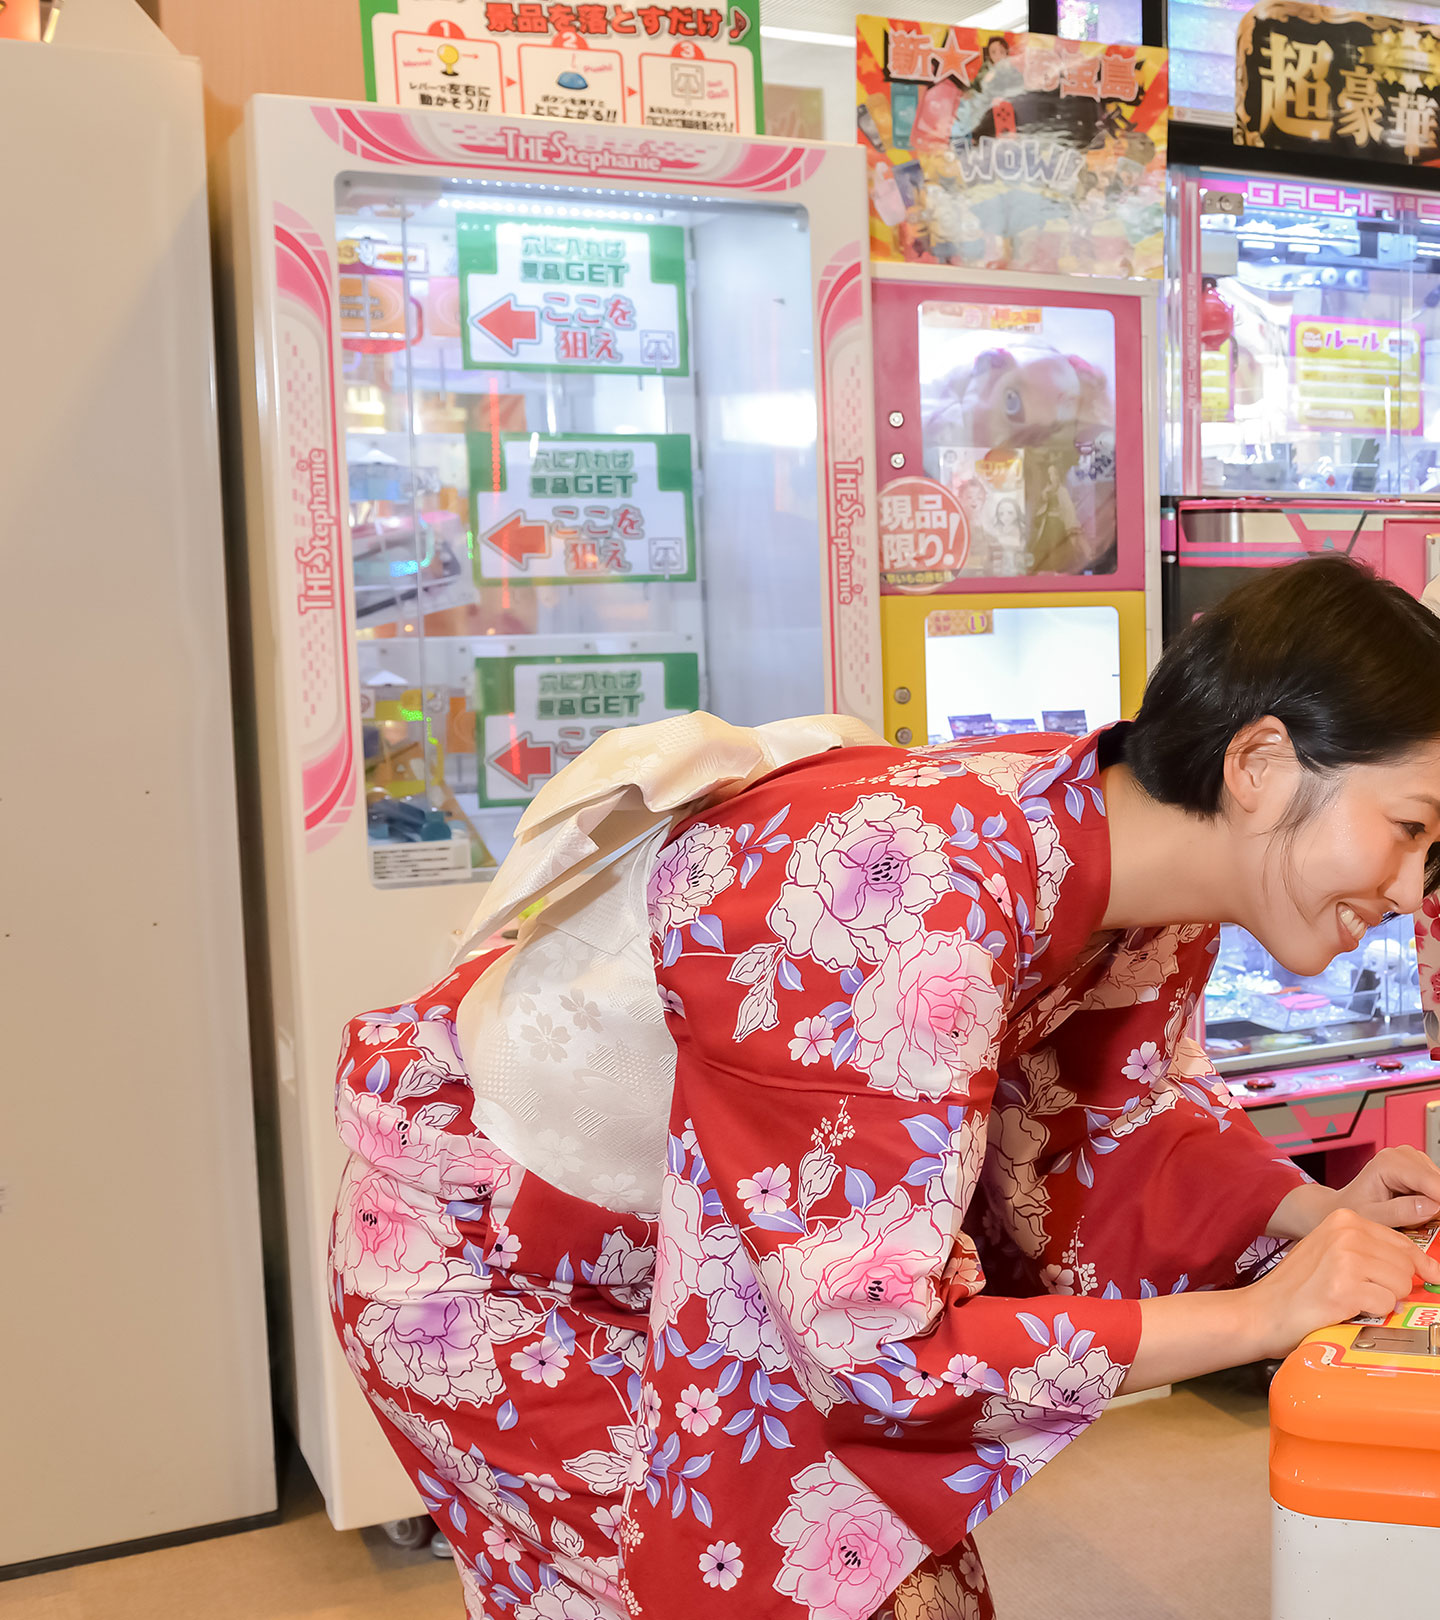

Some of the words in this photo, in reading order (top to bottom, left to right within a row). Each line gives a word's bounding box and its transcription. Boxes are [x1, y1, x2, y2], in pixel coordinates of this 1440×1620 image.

[440, 21, 450, 36] 1
[562, 34, 577, 48] 2
[681, 43, 695, 58] 3
[545, 293, 634, 329] ここを
[558, 328, 619, 360] 狙え
[552, 506, 642, 537] ここを
[879, 494, 948, 530] 現品
